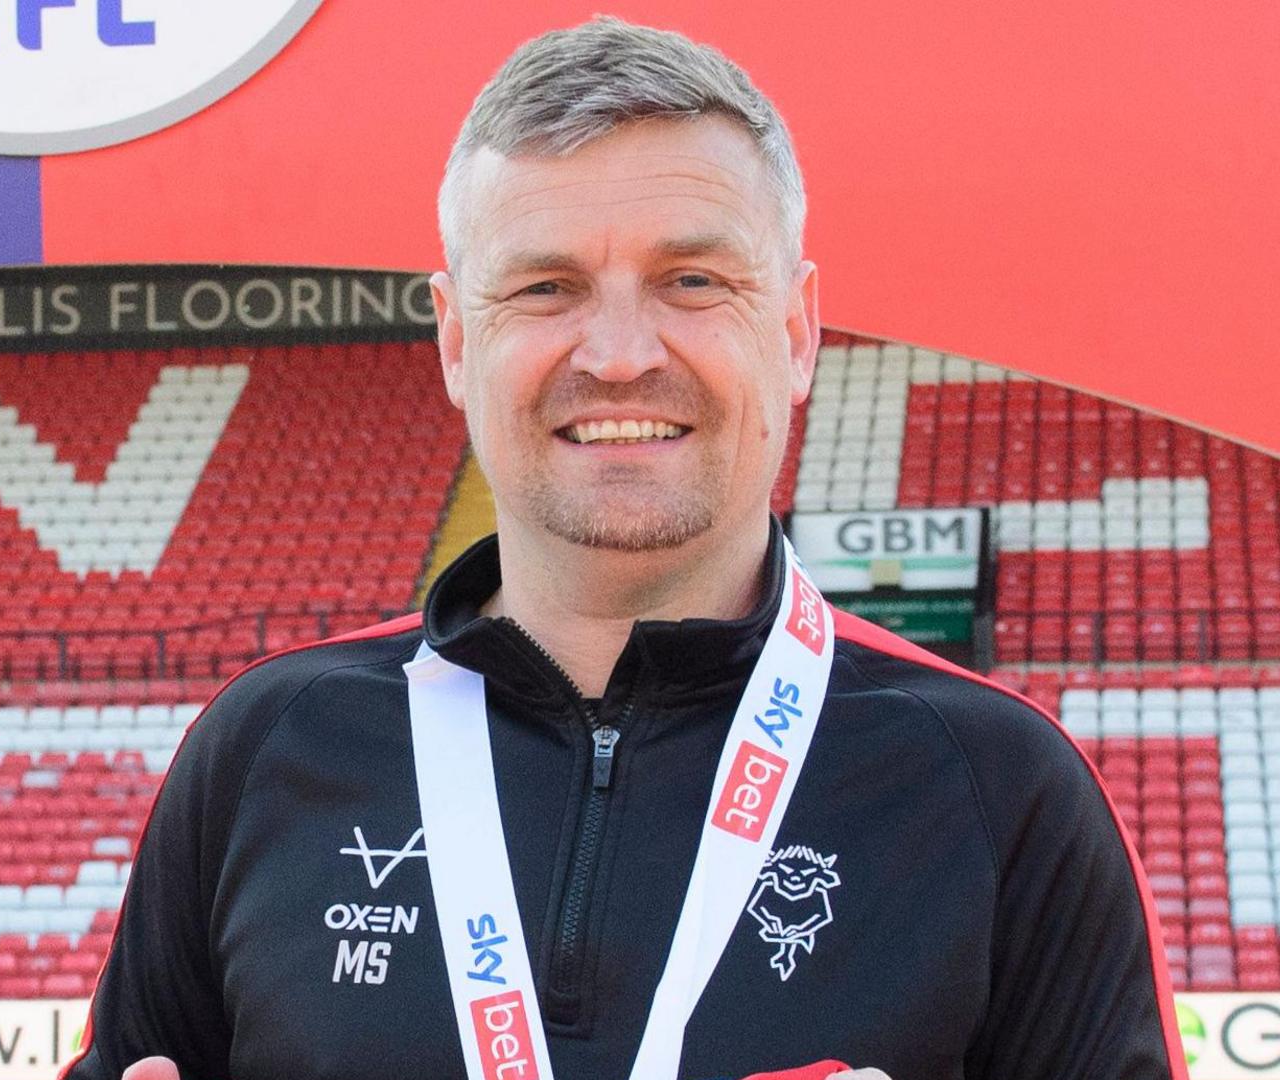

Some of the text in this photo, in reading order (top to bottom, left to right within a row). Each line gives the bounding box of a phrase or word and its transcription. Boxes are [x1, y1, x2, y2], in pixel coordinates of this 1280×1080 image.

[110, 274, 437, 331] FLOORING
[837, 516, 966, 554] GBM
[725, 677, 803, 829] sky bet
[324, 903, 419, 934] OXEN
[332, 939, 392, 985] MS
[467, 914, 508, 985] sky
